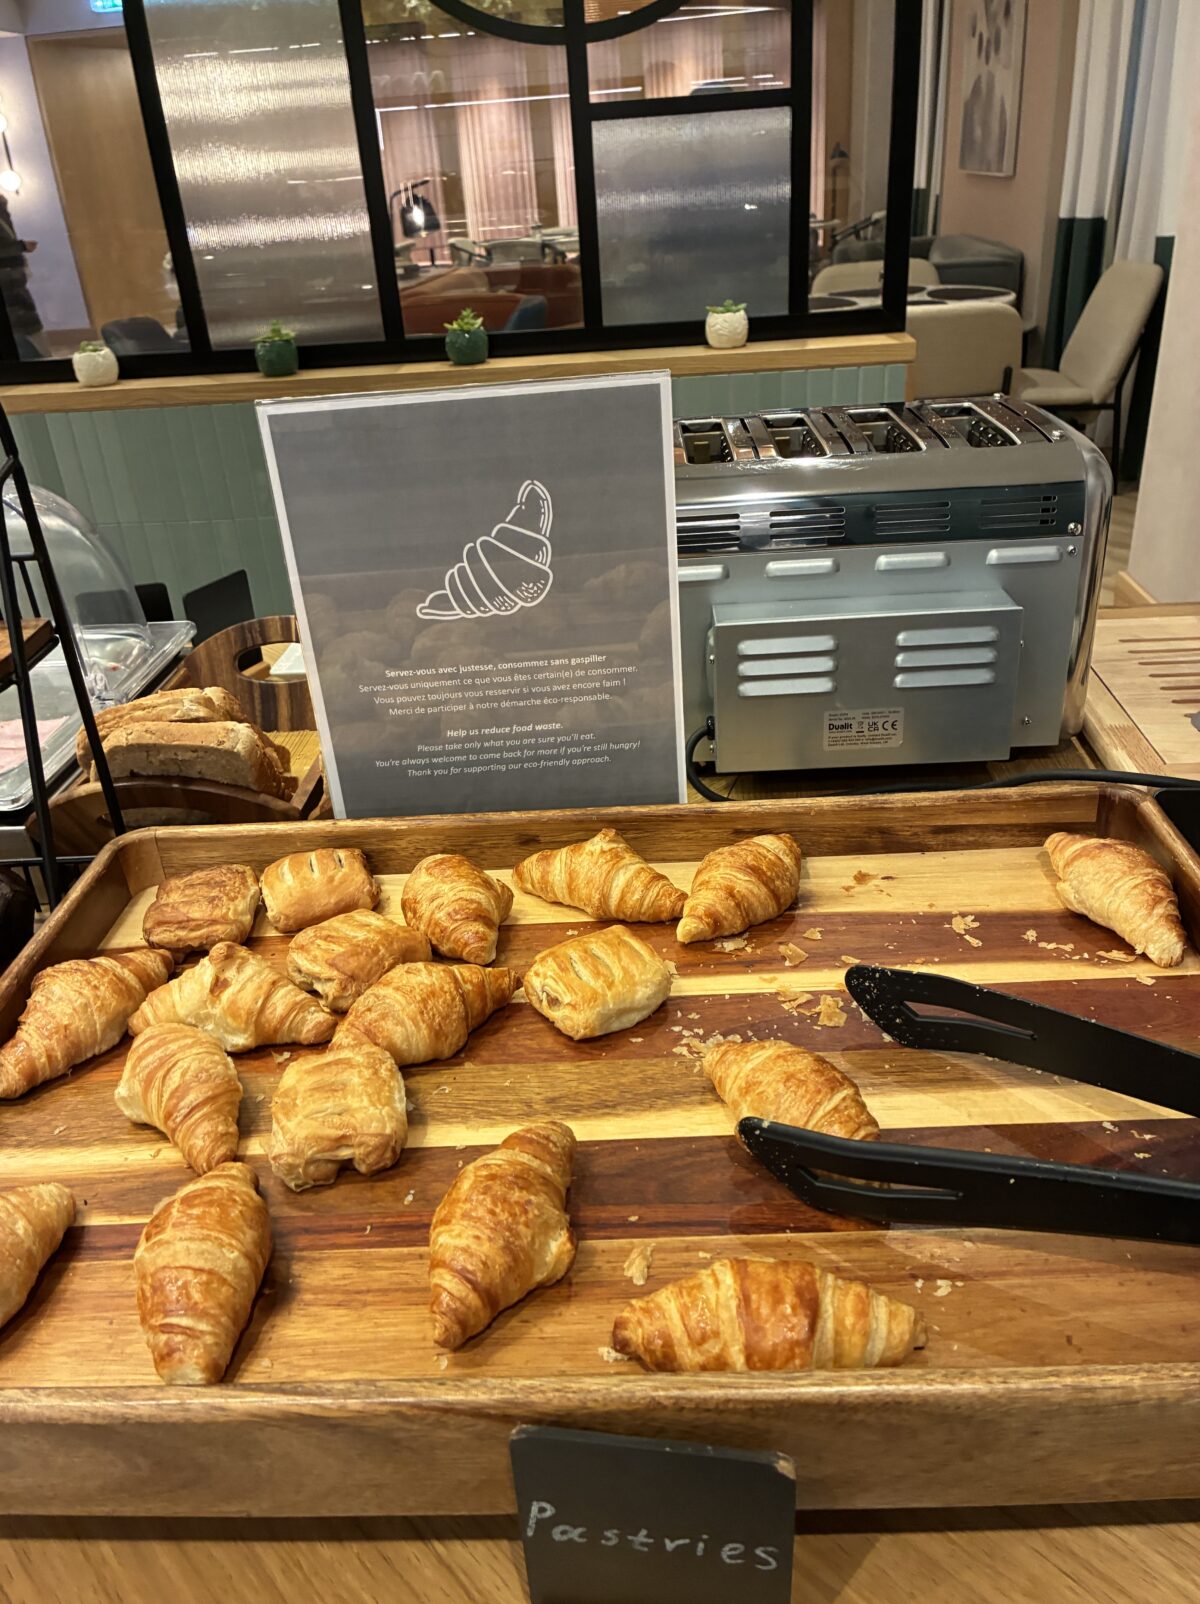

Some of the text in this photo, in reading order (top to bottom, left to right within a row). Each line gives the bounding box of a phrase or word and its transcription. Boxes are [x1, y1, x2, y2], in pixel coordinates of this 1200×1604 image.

[385, 668, 436, 677] Servez-vous
[459, 664, 496, 674] justesse,
[498, 659, 548, 670] consommez
[571, 655, 607, 666] gaspiller
[359, 682, 408, 693] Servez-vous
[411, 679, 460, 689] uniquement
[475, 677, 490, 686] que
[514, 673, 531, 681] êtes
[534, 670, 573, 679] certain(e)
[575, 668, 585, 677] de
[588, 666, 638, 676] consommer.
[396, 695, 426, 704] pouvez
[428, 691, 462, 701] toujours
[486, 687, 520, 696] resservir
[603, 679, 620, 688] faim
[389, 707, 413, 716] Merci
[415, 705, 425, 714] de
[427, 703, 466, 714] participer
[500, 697, 542, 708] démarche
[543, 693, 613, 705] éco-responsable.
[447, 729, 467, 738] Help
[481, 726, 510, 735] reduce
[512, 723, 532, 733] food
[535, 722, 563, 731] waste.
[402, 758, 429, 766] always
[432, 755, 466, 763] welcome
[503, 749, 522, 758] back
[523, 749, 534, 758] for
[560, 746, 565, 755] if
[610, 740, 640, 750] hungry!
[445, 742, 462, 750] take
[465, 740, 481, 749] only
[408, 768, 431, 776] Thank
[433, 768, 448, 776] you
[450, 766, 461, 775] for
[464, 763, 506, 774] supporting
[524, 758, 570, 768] eco-friendly
[572, 756, 612, 765] approach.
[526, 1500, 778, 1570] Pastries
